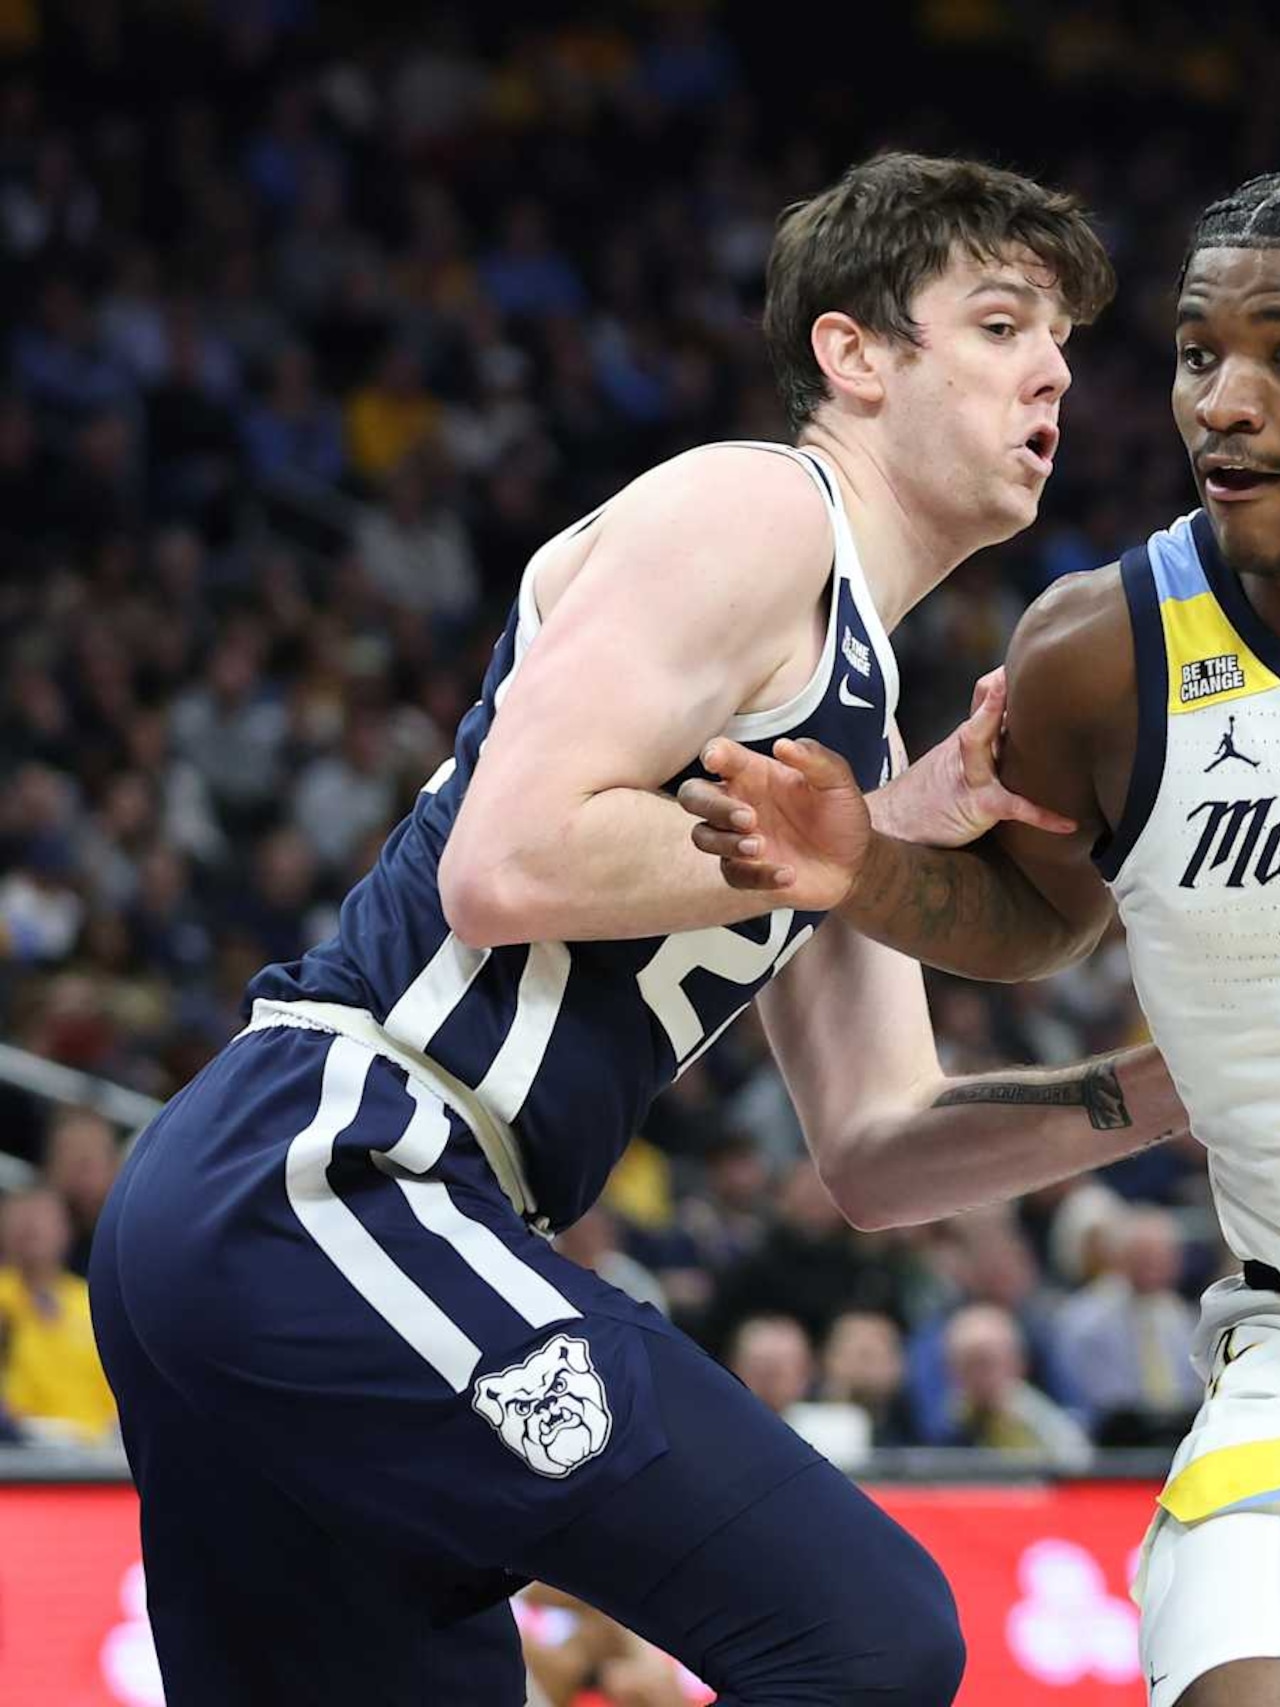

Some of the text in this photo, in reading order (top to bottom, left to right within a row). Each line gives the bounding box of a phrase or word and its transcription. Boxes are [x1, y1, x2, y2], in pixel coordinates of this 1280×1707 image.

[1182, 655, 1238, 683] BE THE
[1181, 670, 1244, 701] CHANGE
[636, 907, 814, 1080] 2
